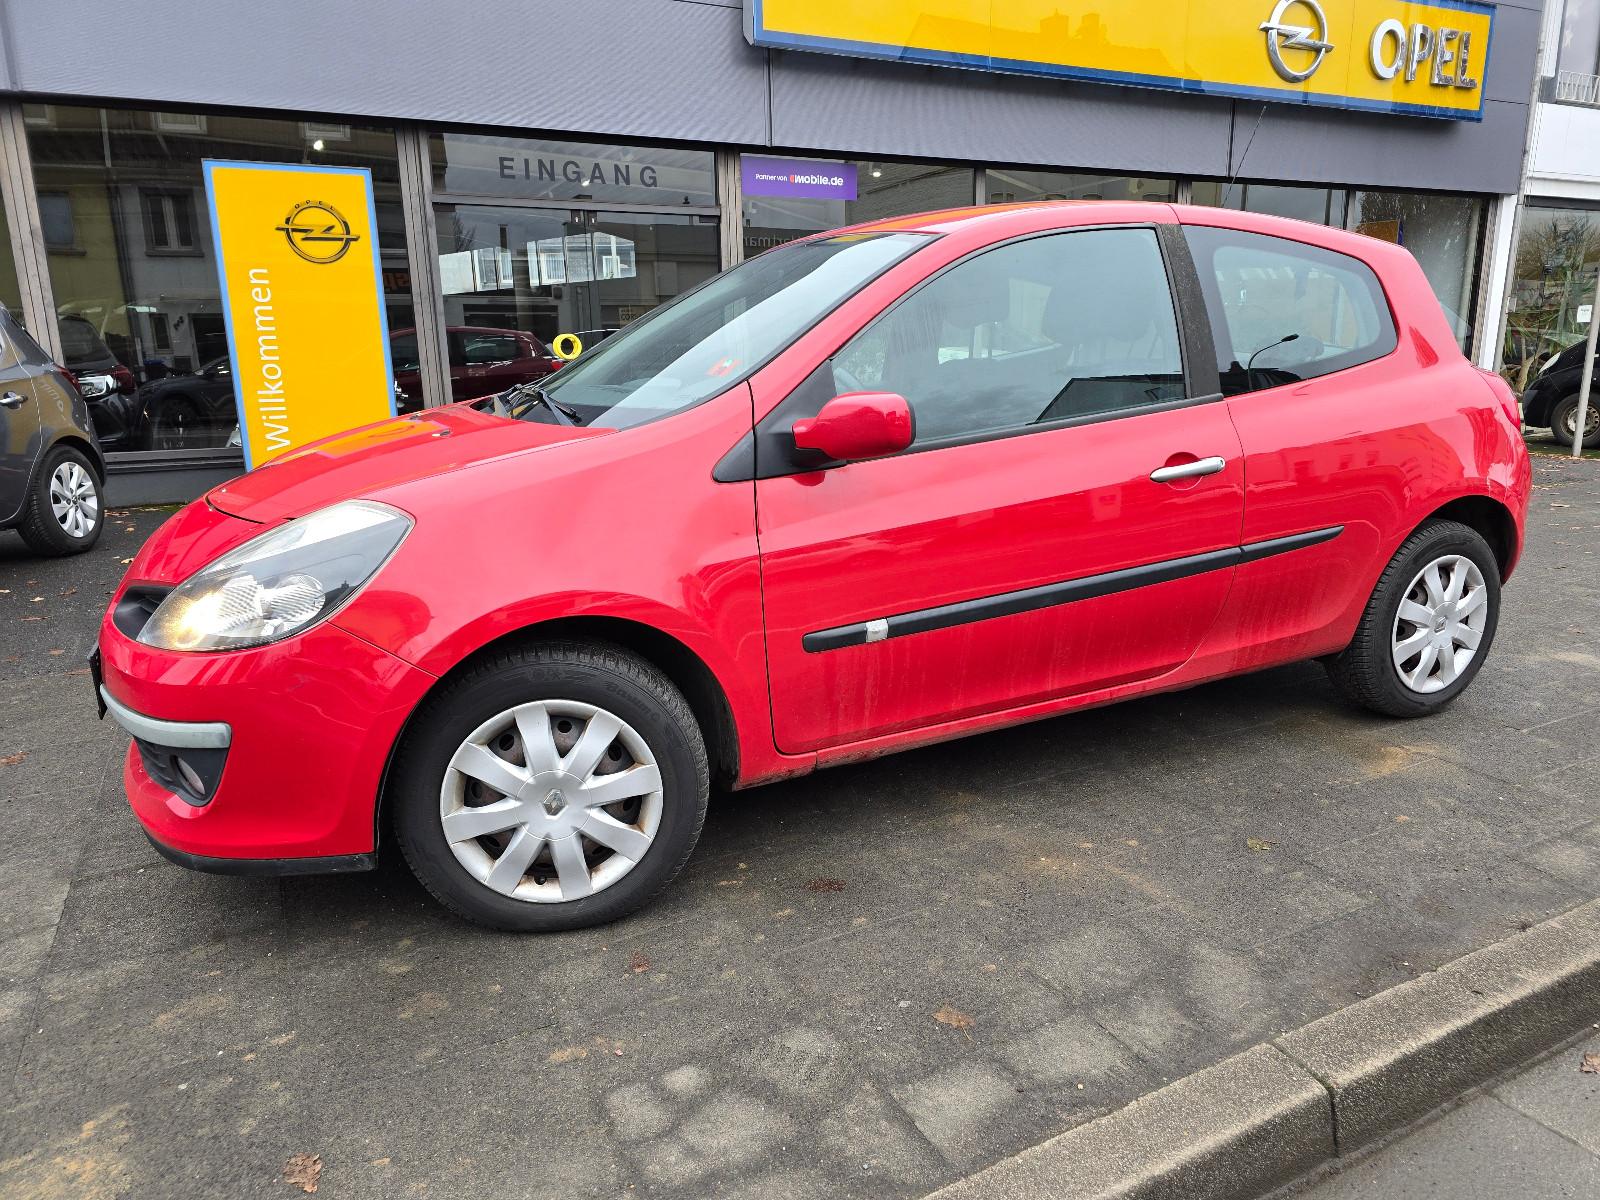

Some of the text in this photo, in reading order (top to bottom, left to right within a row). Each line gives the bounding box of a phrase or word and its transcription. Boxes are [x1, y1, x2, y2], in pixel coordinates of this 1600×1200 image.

[1369, 18, 1478, 89] OPEL
[498, 156, 658, 188] EINGANG
[755, 173, 776, 182] Partner
[794, 174, 844, 186] mobile.de
[248, 267, 291, 452] Willkommen
